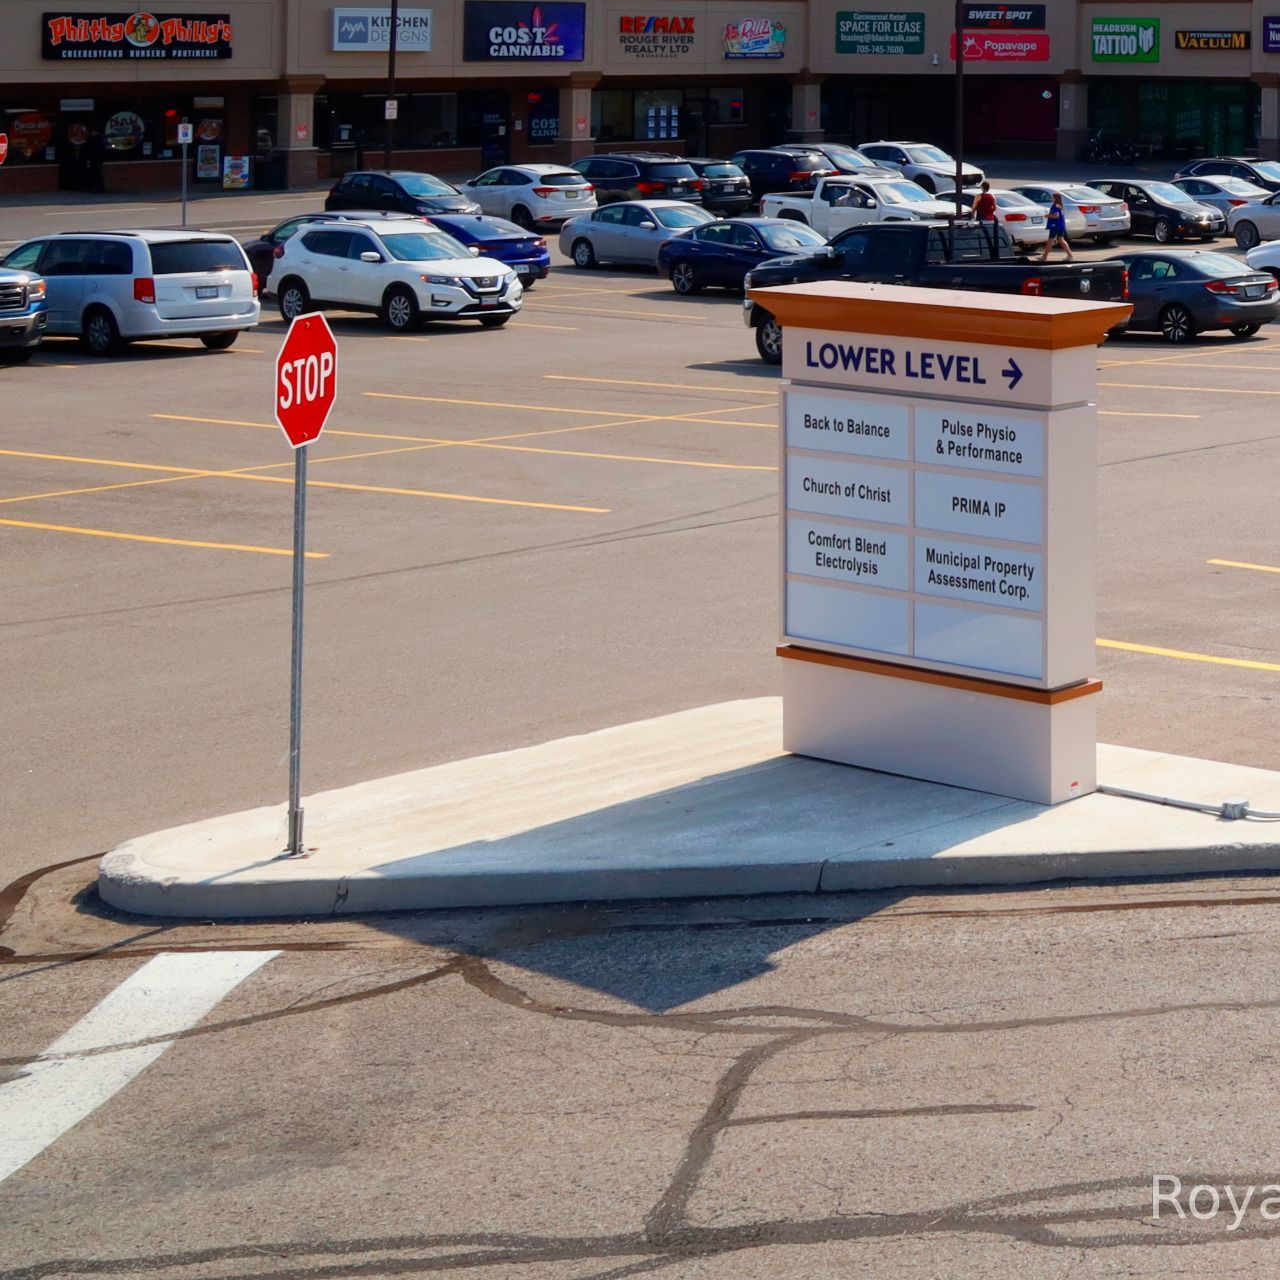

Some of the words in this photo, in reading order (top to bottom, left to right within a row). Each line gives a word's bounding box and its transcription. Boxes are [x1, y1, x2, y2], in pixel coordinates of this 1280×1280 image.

[371, 16, 429, 27] KITCHEN
[853, 13, 888, 21] Commercial
[968, 10, 1003, 19] SWEET
[1005, 10, 1033, 19] SPOT
[48, 16, 124, 46] Philthy
[160, 17, 233, 45] Philly's
[620, 16, 696, 33] RE/MAX
[840, 21, 871, 33] SPACE
[873, 21, 891, 33] FOR
[893, 21, 922, 33] LEASE
[1093, 24, 1137, 32] HEADRUSH
[371, 30, 429, 42] DEIGNS
[489, 27, 547, 44] COST
[619, 35, 659, 44] ROUGE
[662, 35, 694, 44] RIVER
[1093, 34, 1138, 55] TATTOO
[61, 49, 123, 58] CHEESESTEAKS
[130, 49, 166, 58] BURGERS
[489, 44, 565, 57] CANNABIS
[624, 45, 666, 54] REALTY
[669, 45, 689, 54] LTD
[984, 40, 1037, 53] Popavape
[531, 118, 560, 129] COS
[806, 341, 897, 376] LOWER
[905, 351, 987, 385] LEVEL
[280, 351, 333, 409] STOP
[803, 413, 830, 432] Back
[833, 415, 844, 432] to
[847, 418, 891, 438] Balance
[941, 419, 974, 438] Pulse
[976, 421, 1017, 444] Physio
[936, 439, 945, 455] &
[948, 441, 1023, 465] Performance
[803, 477, 842, 497] Church
[844, 482, 856, 498] of
[858, 484, 892, 504] Christ
[952, 497, 991, 517] PRIMA
[994, 501, 1006, 518] IP
[808, 531, 852, 552] Comfort
[855, 536, 887, 556] Blend
[815, 552, 878, 576] Electrolysis
[926, 547, 981, 571] Municipal
[984, 556, 1035, 582] Property
[928, 570, 997, 594] Assessment
[999, 580, 1031, 601] Corp.
